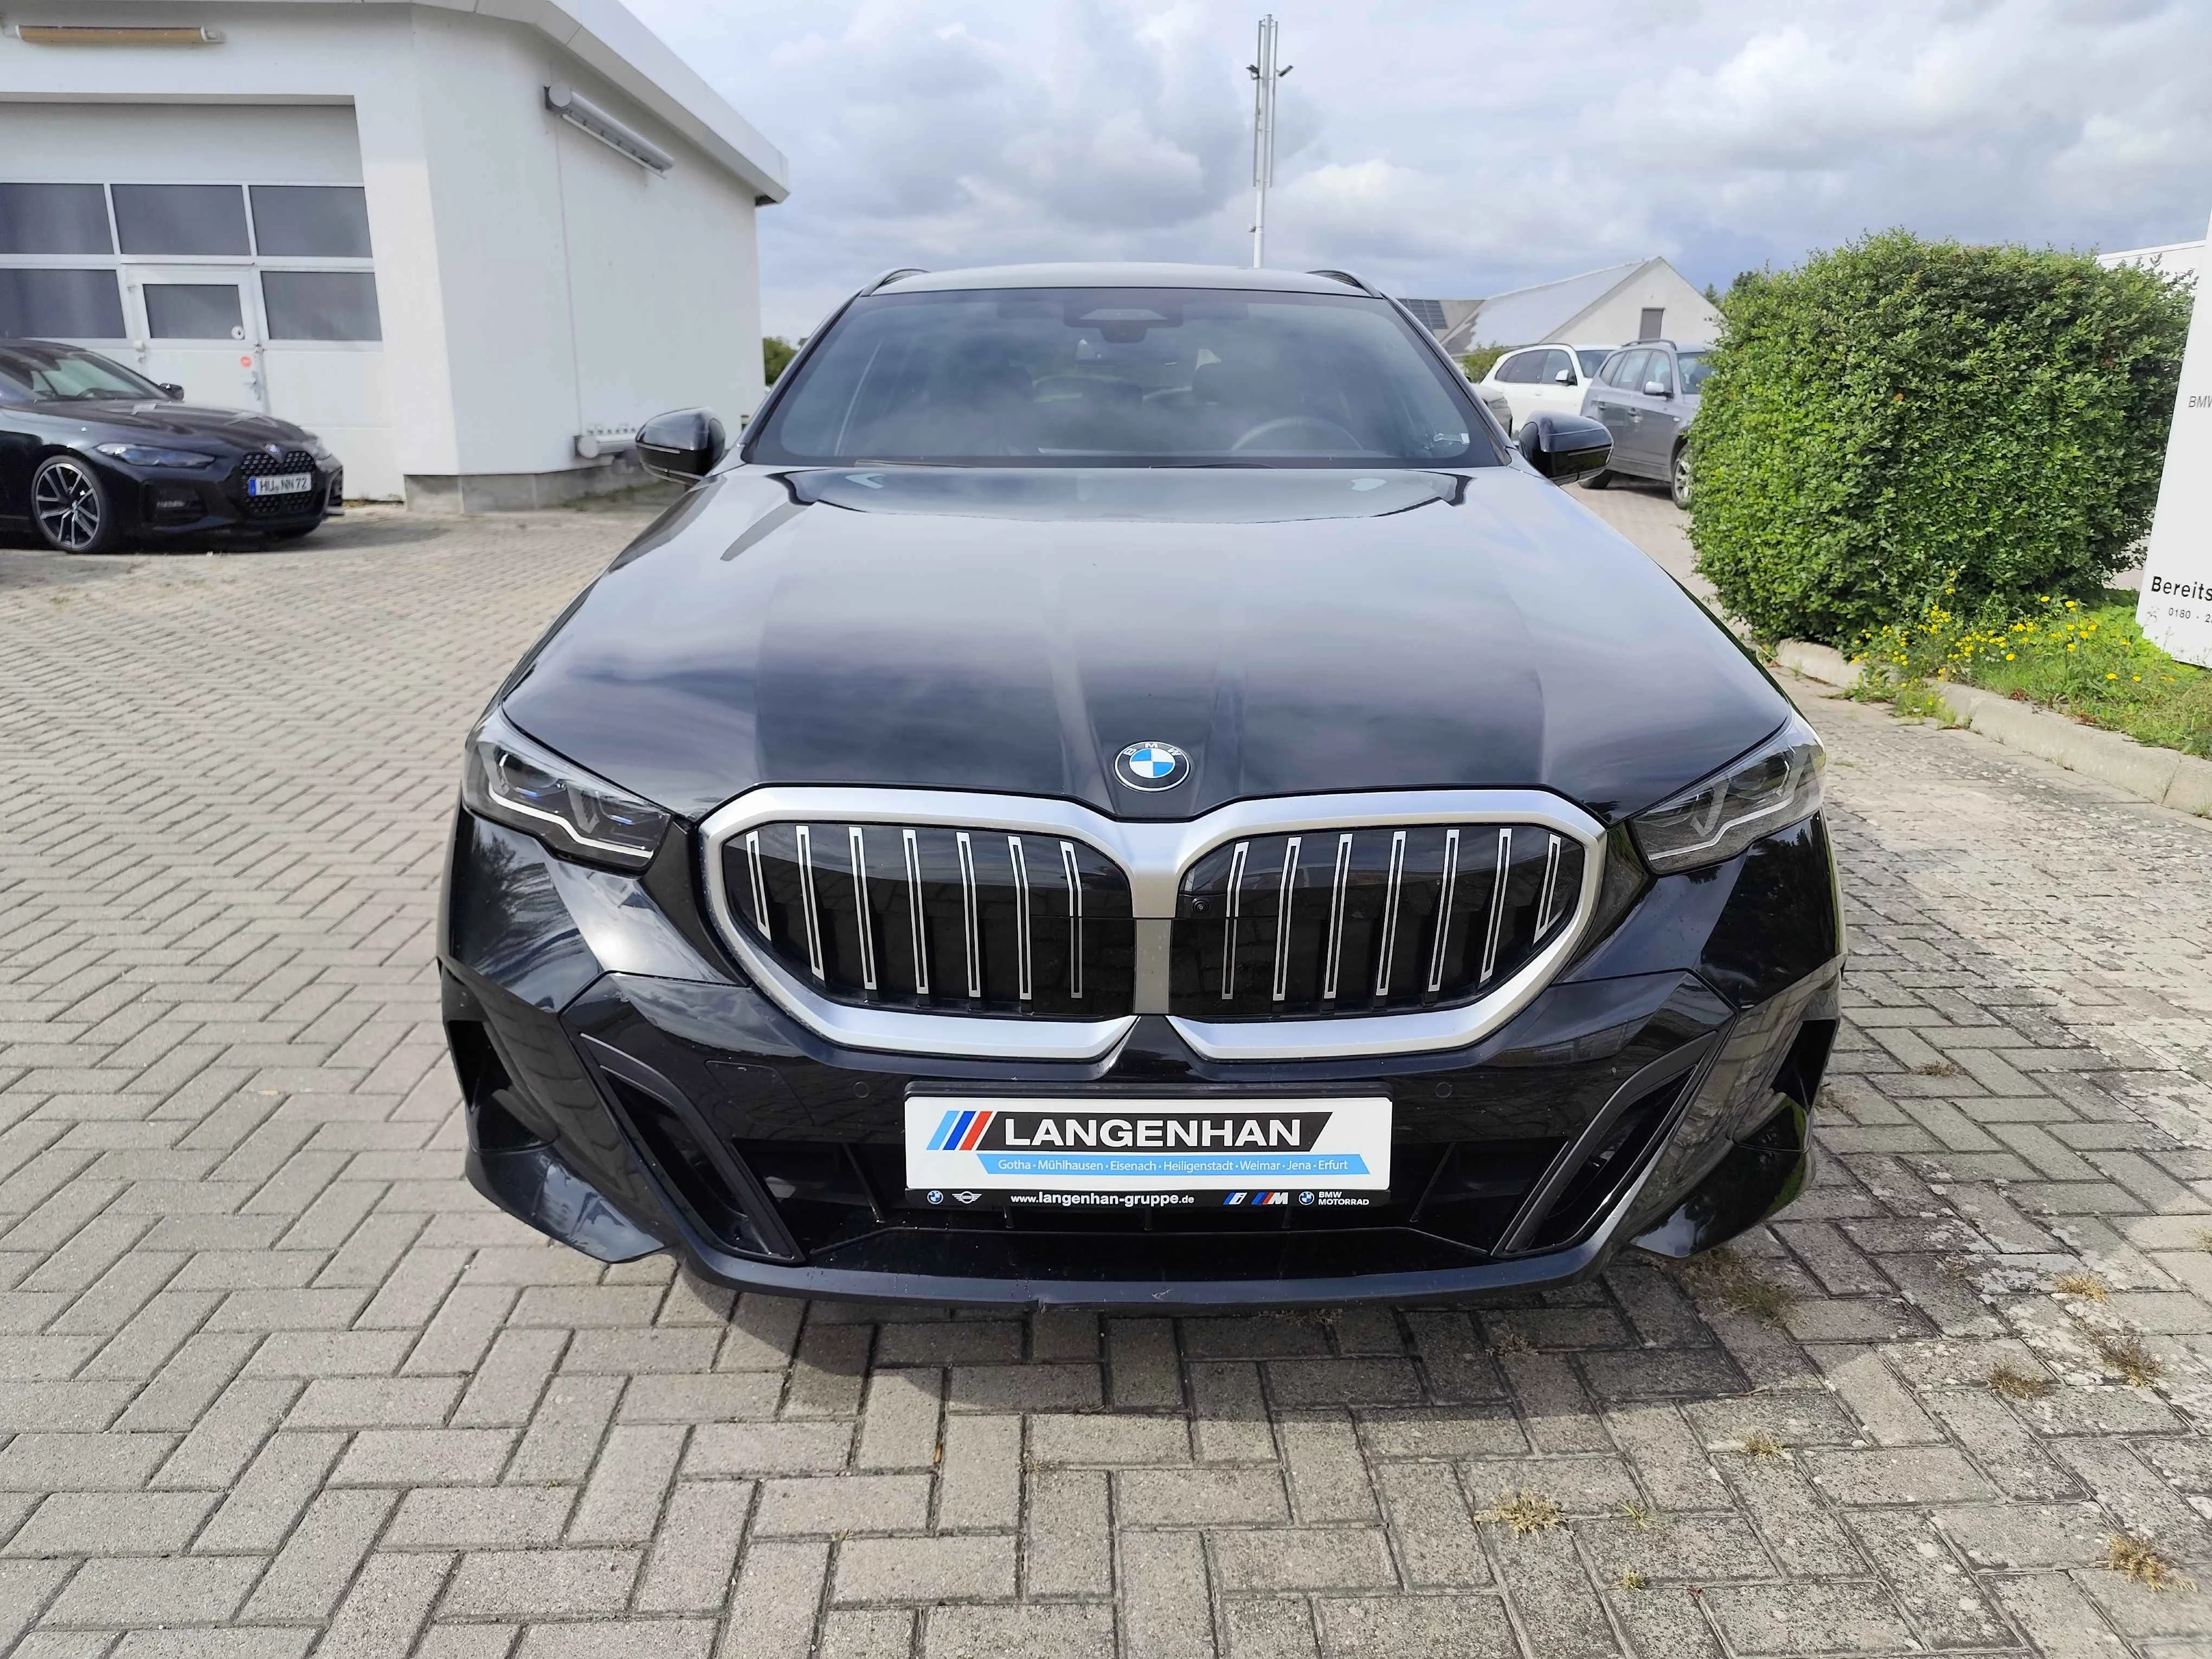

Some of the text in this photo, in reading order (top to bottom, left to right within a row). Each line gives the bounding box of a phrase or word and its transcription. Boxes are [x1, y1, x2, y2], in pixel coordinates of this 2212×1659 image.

[296, 476, 307, 489] 72
[2169, 608, 2212, 623] 0180 2
[1123, 743, 1181, 756] BMW
[1006, 1118, 1300, 1147] LANGENHAN
[998, 1159, 1348, 1173] Gotha Mühlhausen Eisenach Heiligenstadt Weimar Jena Erfurt
[1011, 1191, 1194, 1207] www.langenhan-gruppe.de
